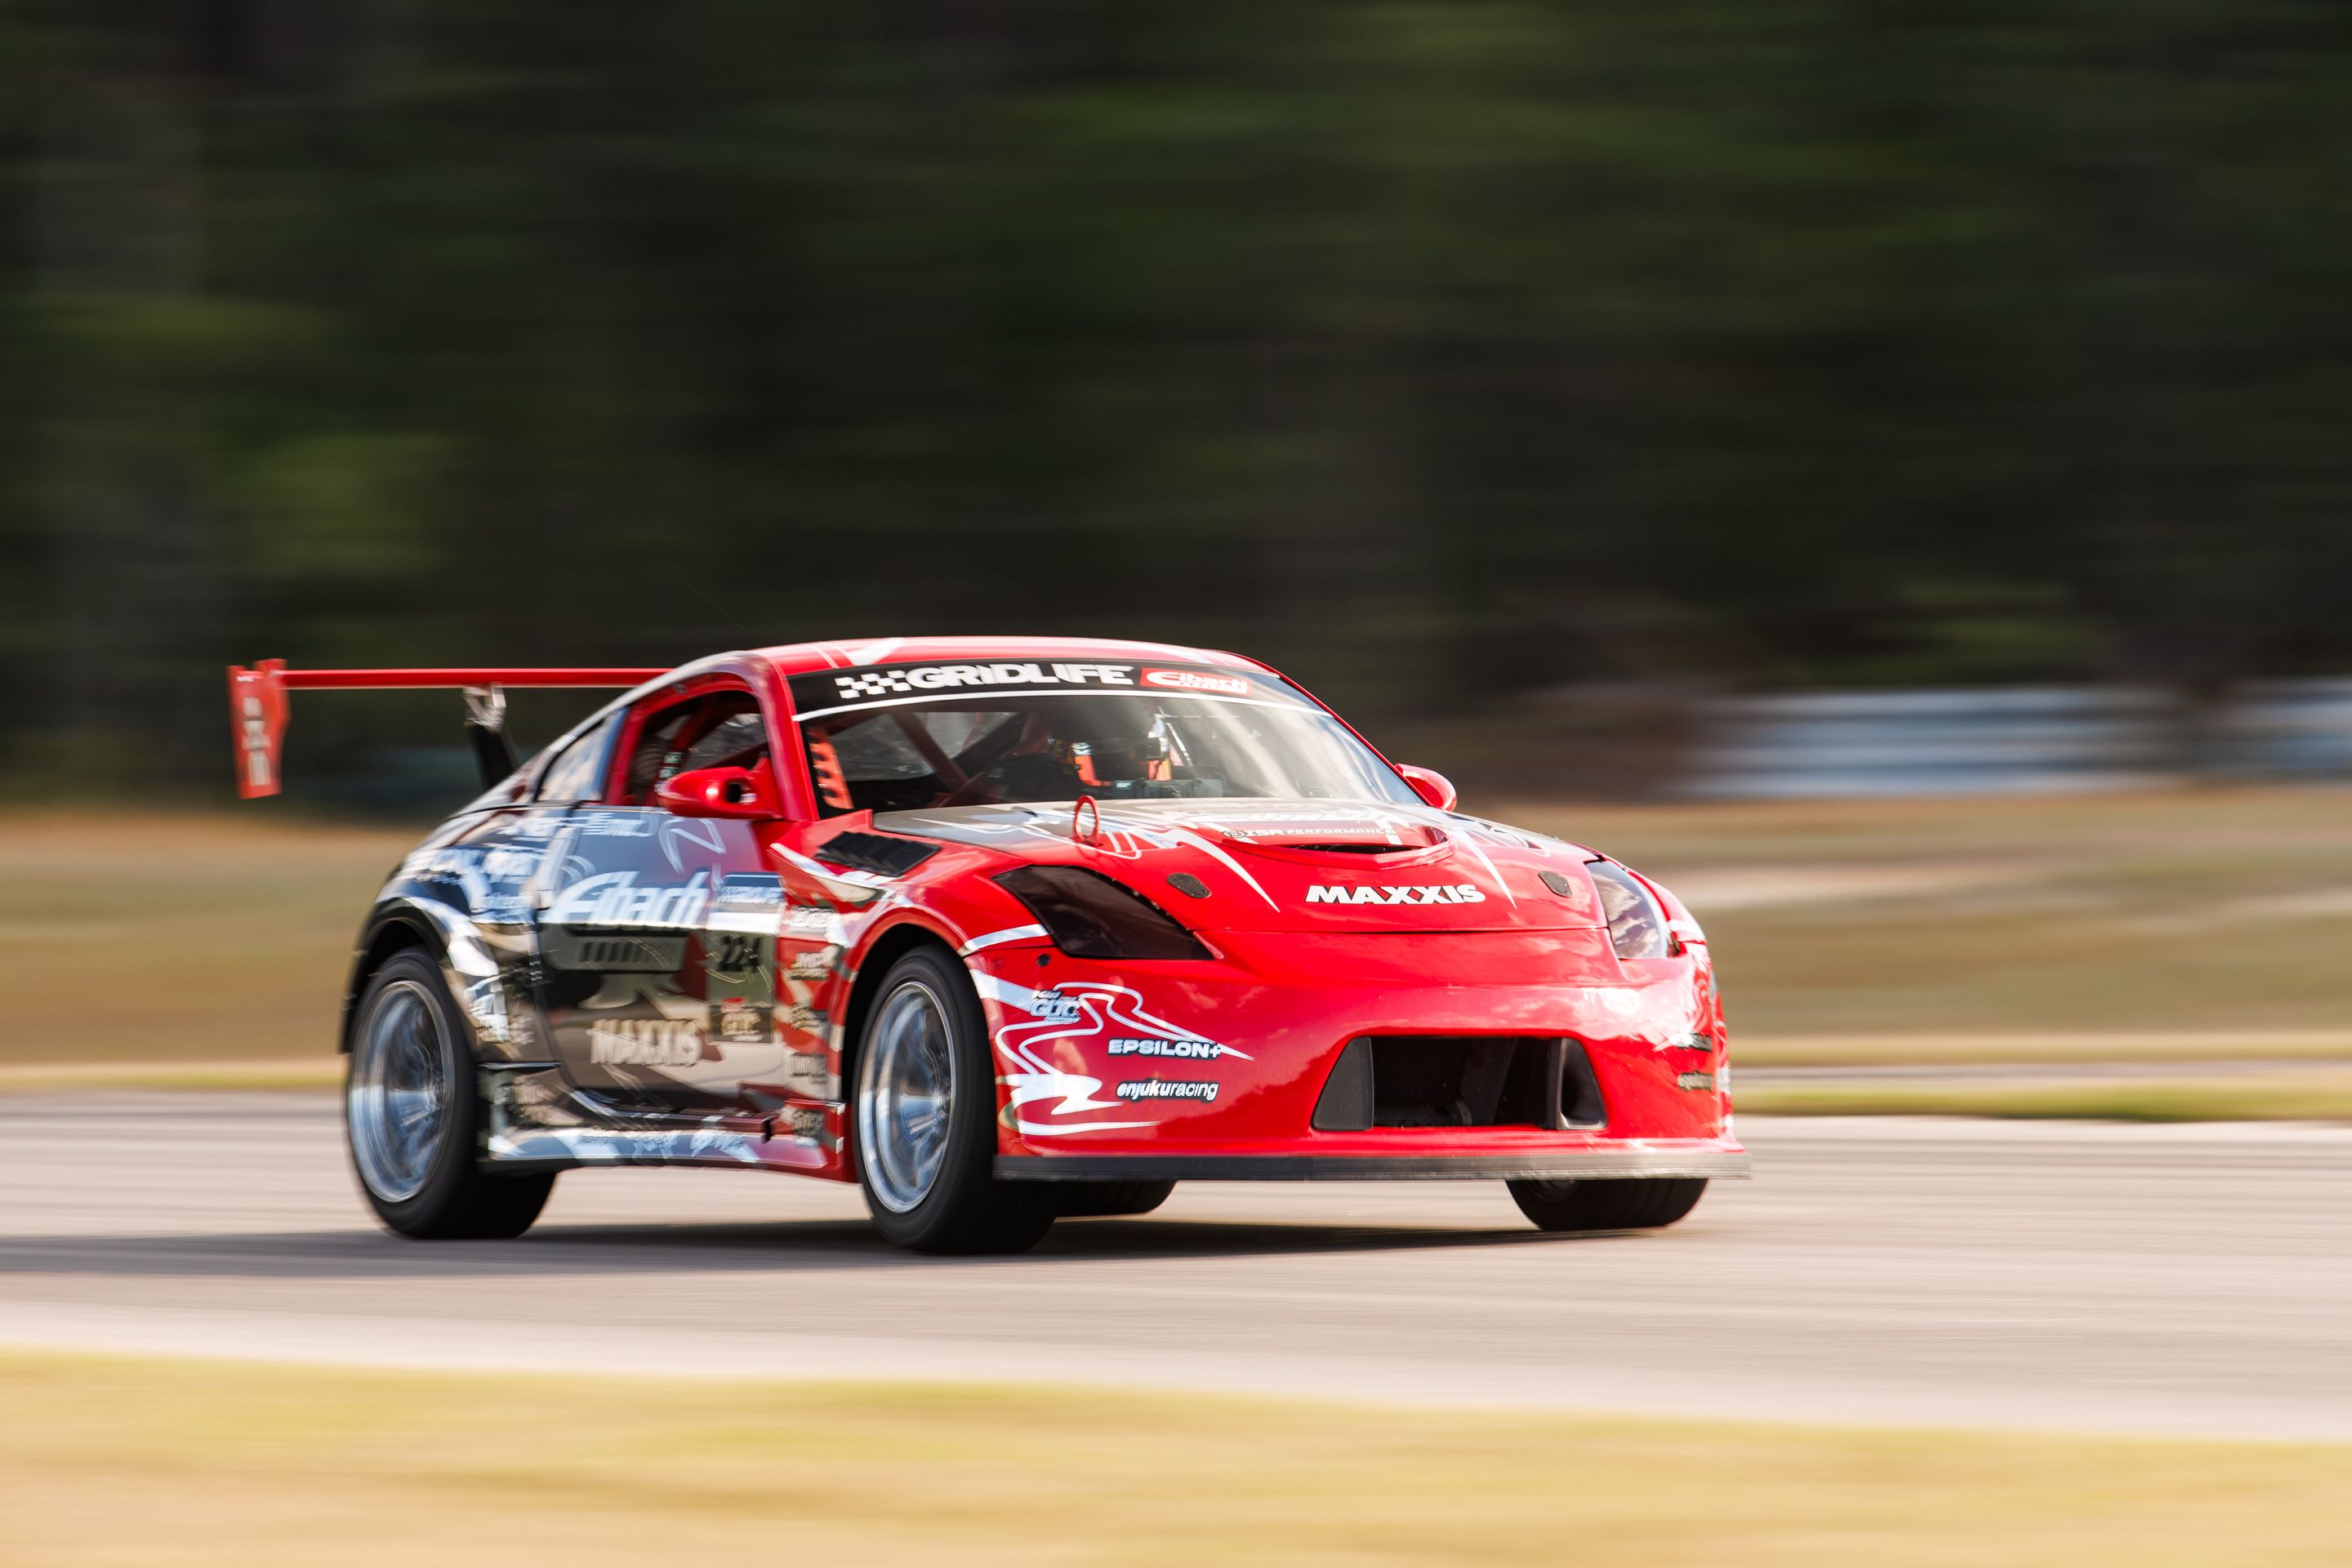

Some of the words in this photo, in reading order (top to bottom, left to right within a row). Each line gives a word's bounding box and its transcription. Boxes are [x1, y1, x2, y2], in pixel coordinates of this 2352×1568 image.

[905, 663, 1135, 688] GRIDLIFE
[1305, 884, 1486, 904] MAXXIS
[717, 935, 761, 972] 224
[590, 1019, 702, 1066] MAXXIS
[1108, 1039, 1221, 1058] EPSILON+
